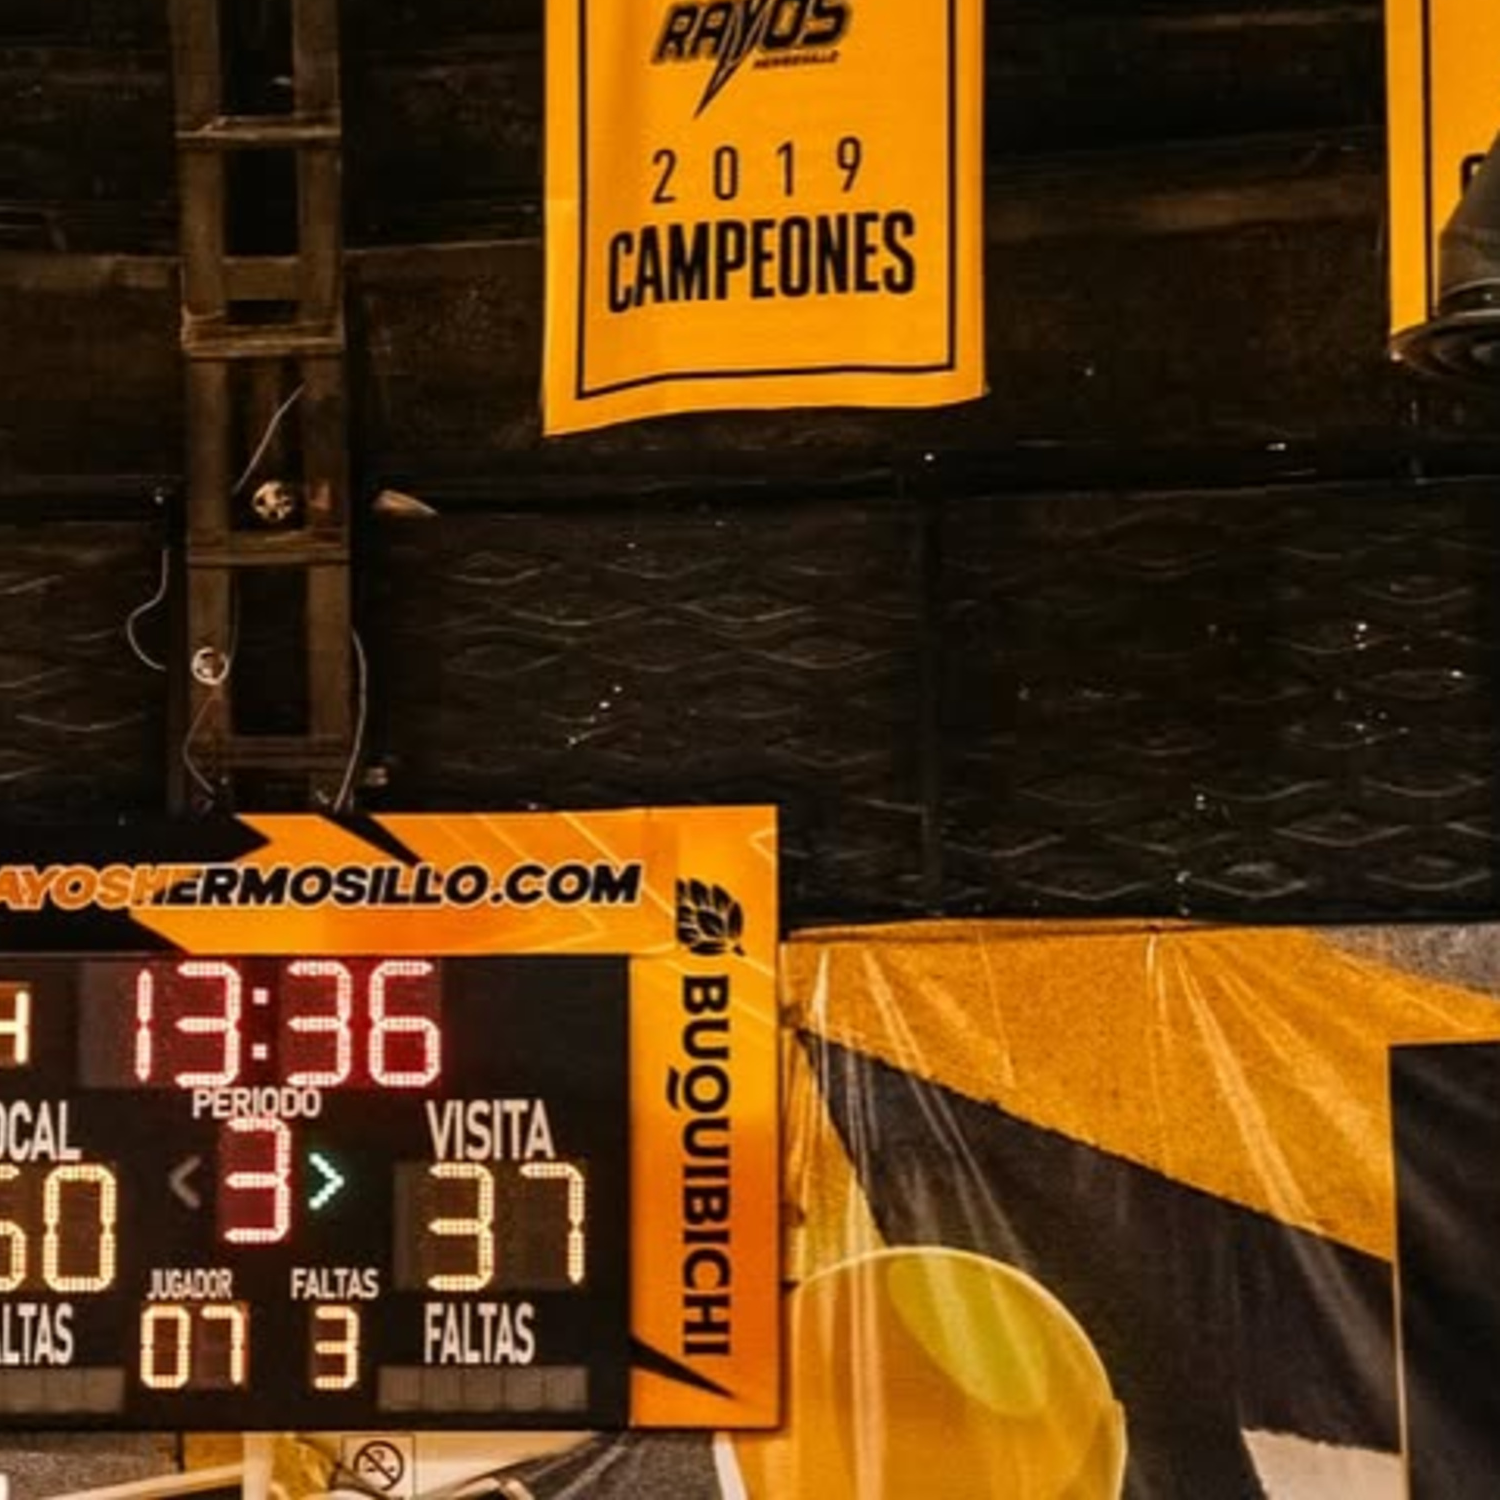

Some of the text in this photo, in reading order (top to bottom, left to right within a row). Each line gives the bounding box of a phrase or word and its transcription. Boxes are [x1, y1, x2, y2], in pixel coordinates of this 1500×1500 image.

[608, 211, 915, 314] CAMPEONES
[136, 960, 441, 1088] 13:36
[192, 1087, 322, 1119] PERIODO
[428, 1100, 556, 1161] VISITA
[224, 1117, 292, 1243] 3
[665, 974, 732, 1356] BUQUIBICHI
[427, 1162, 586, 1292] 37
[145, 1268, 233, 1301] JUGADOR
[290, 1267, 380, 1300] FALTAS
[140, 1304, 246, 1389] 07
[313, 1305, 360, 1390] 3
[424, 1303, 536, 1366] FALTAS
